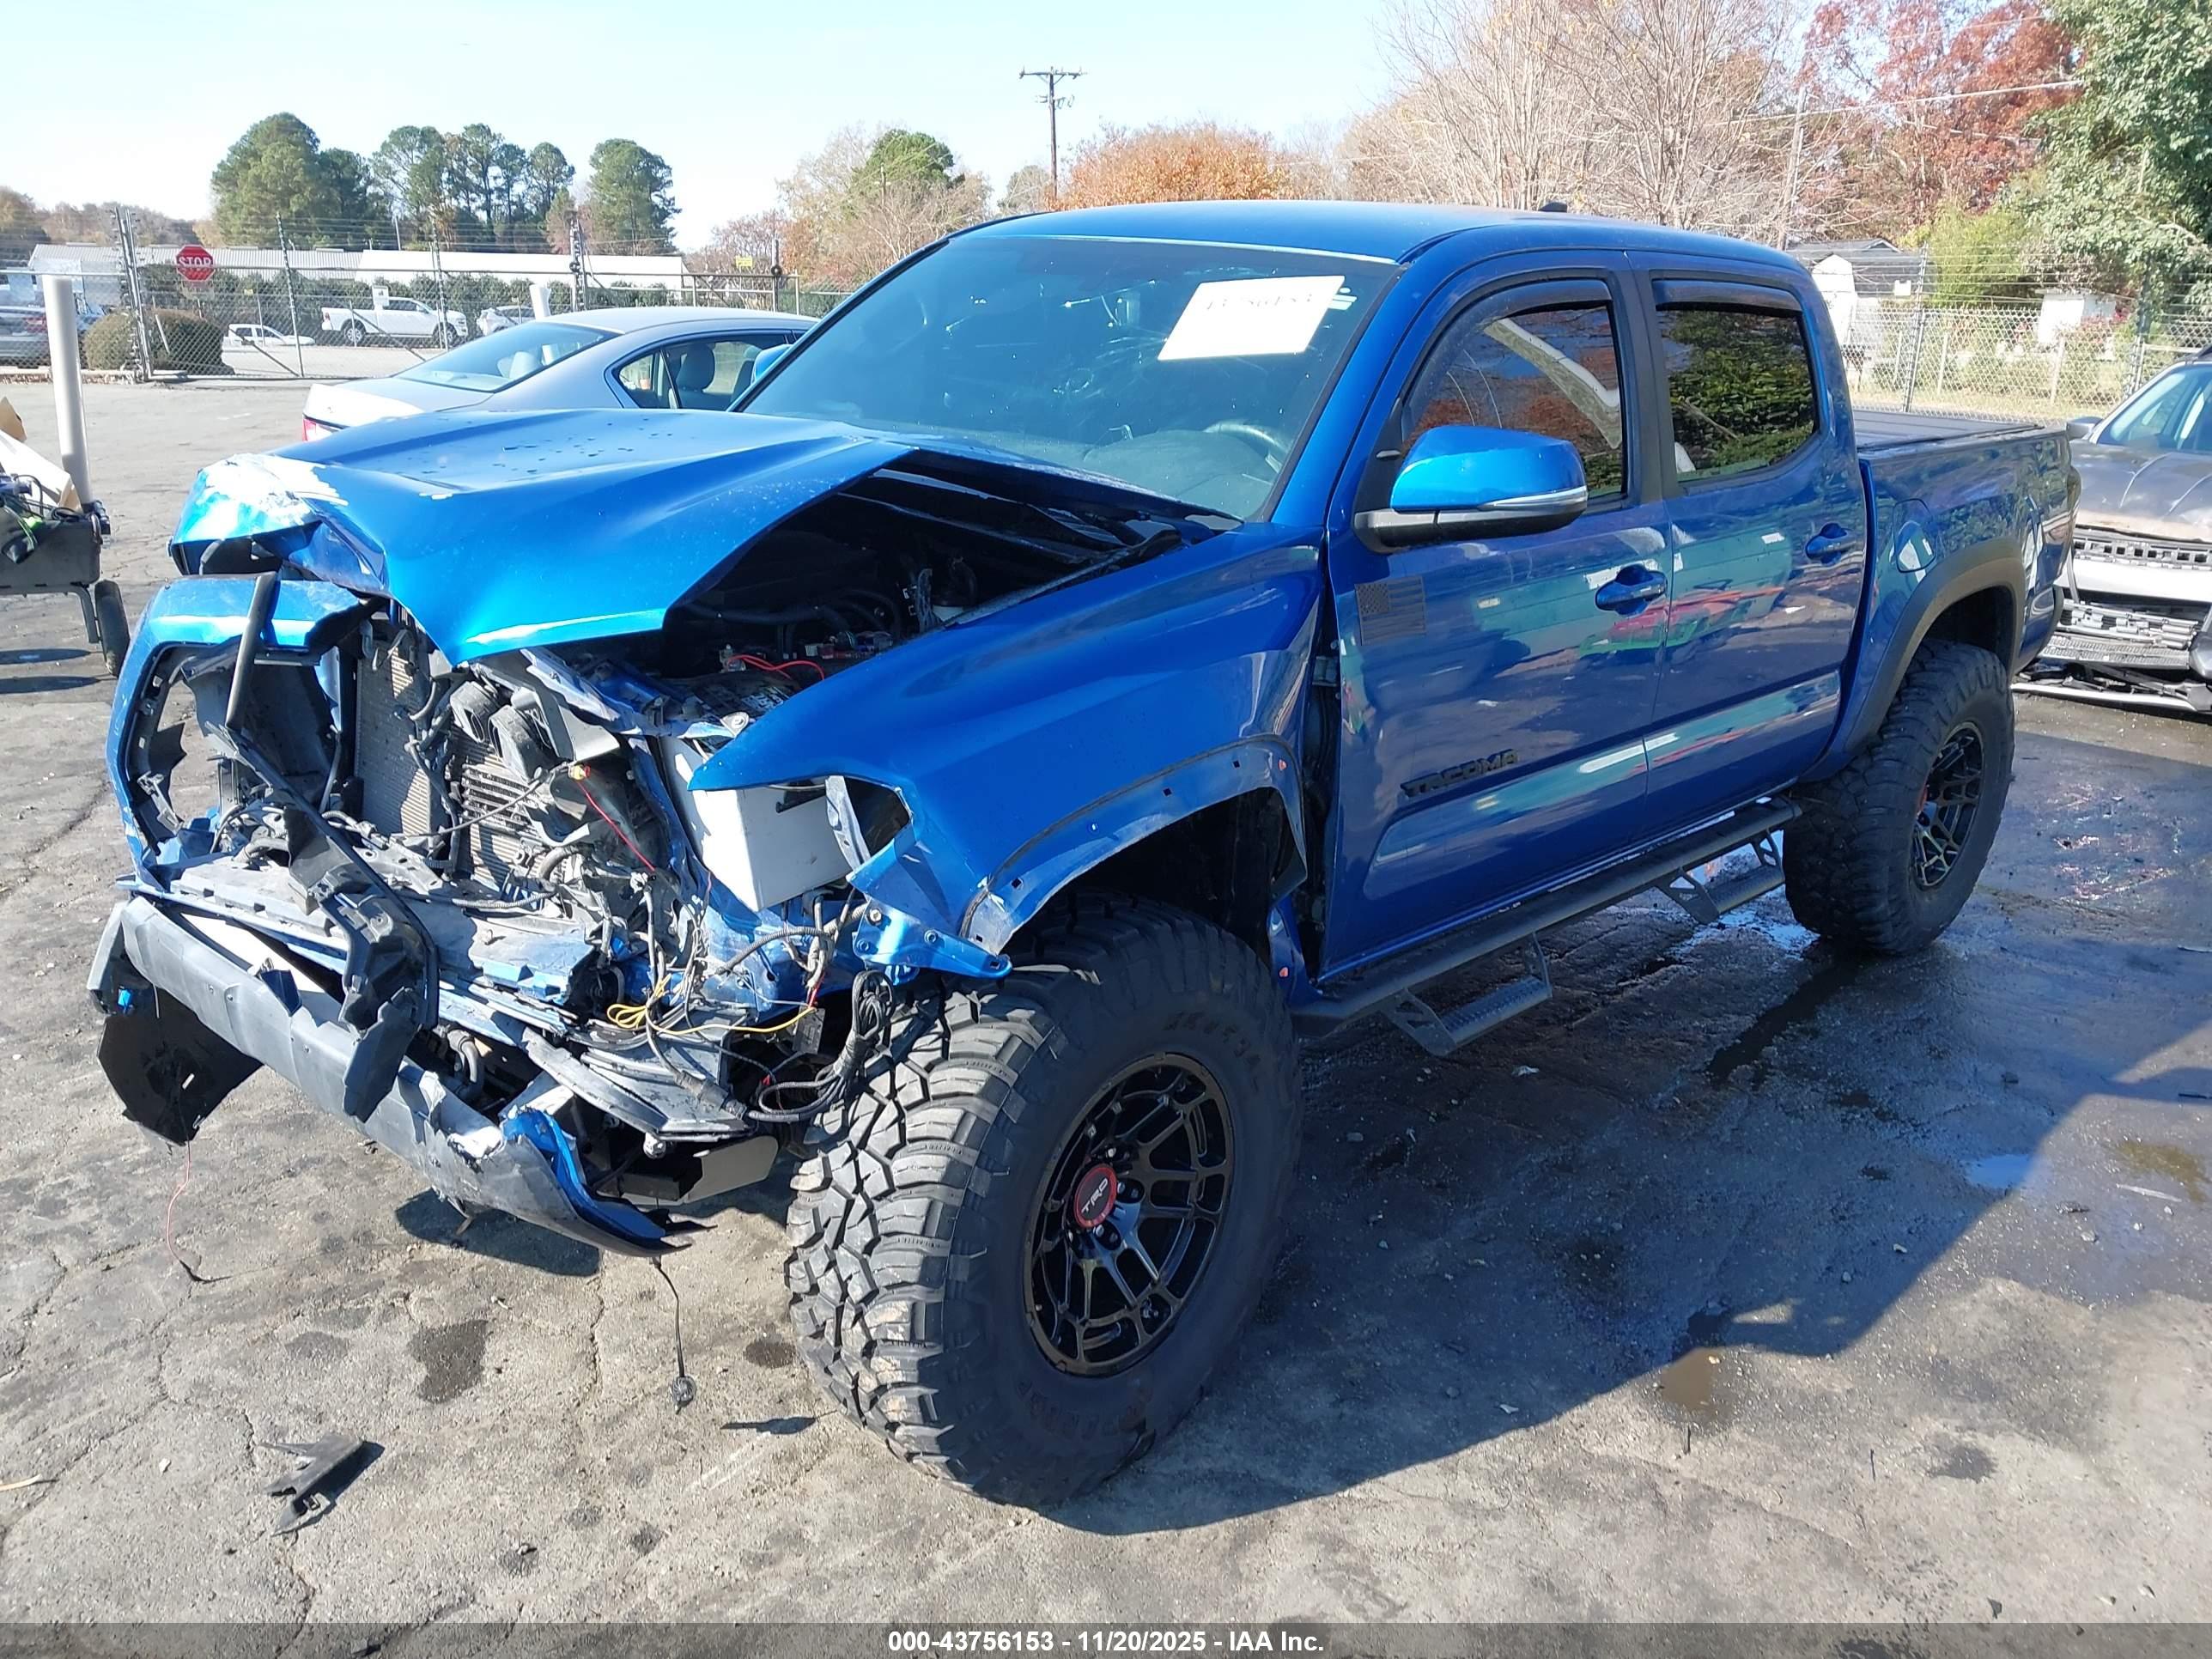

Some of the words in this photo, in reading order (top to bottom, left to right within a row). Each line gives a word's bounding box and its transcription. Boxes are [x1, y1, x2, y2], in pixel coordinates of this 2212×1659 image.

[179, 256, 211, 268] STOP
[1400, 748, 1519, 797] TACOMA
[1080, 1177, 1109, 1213] TRD
